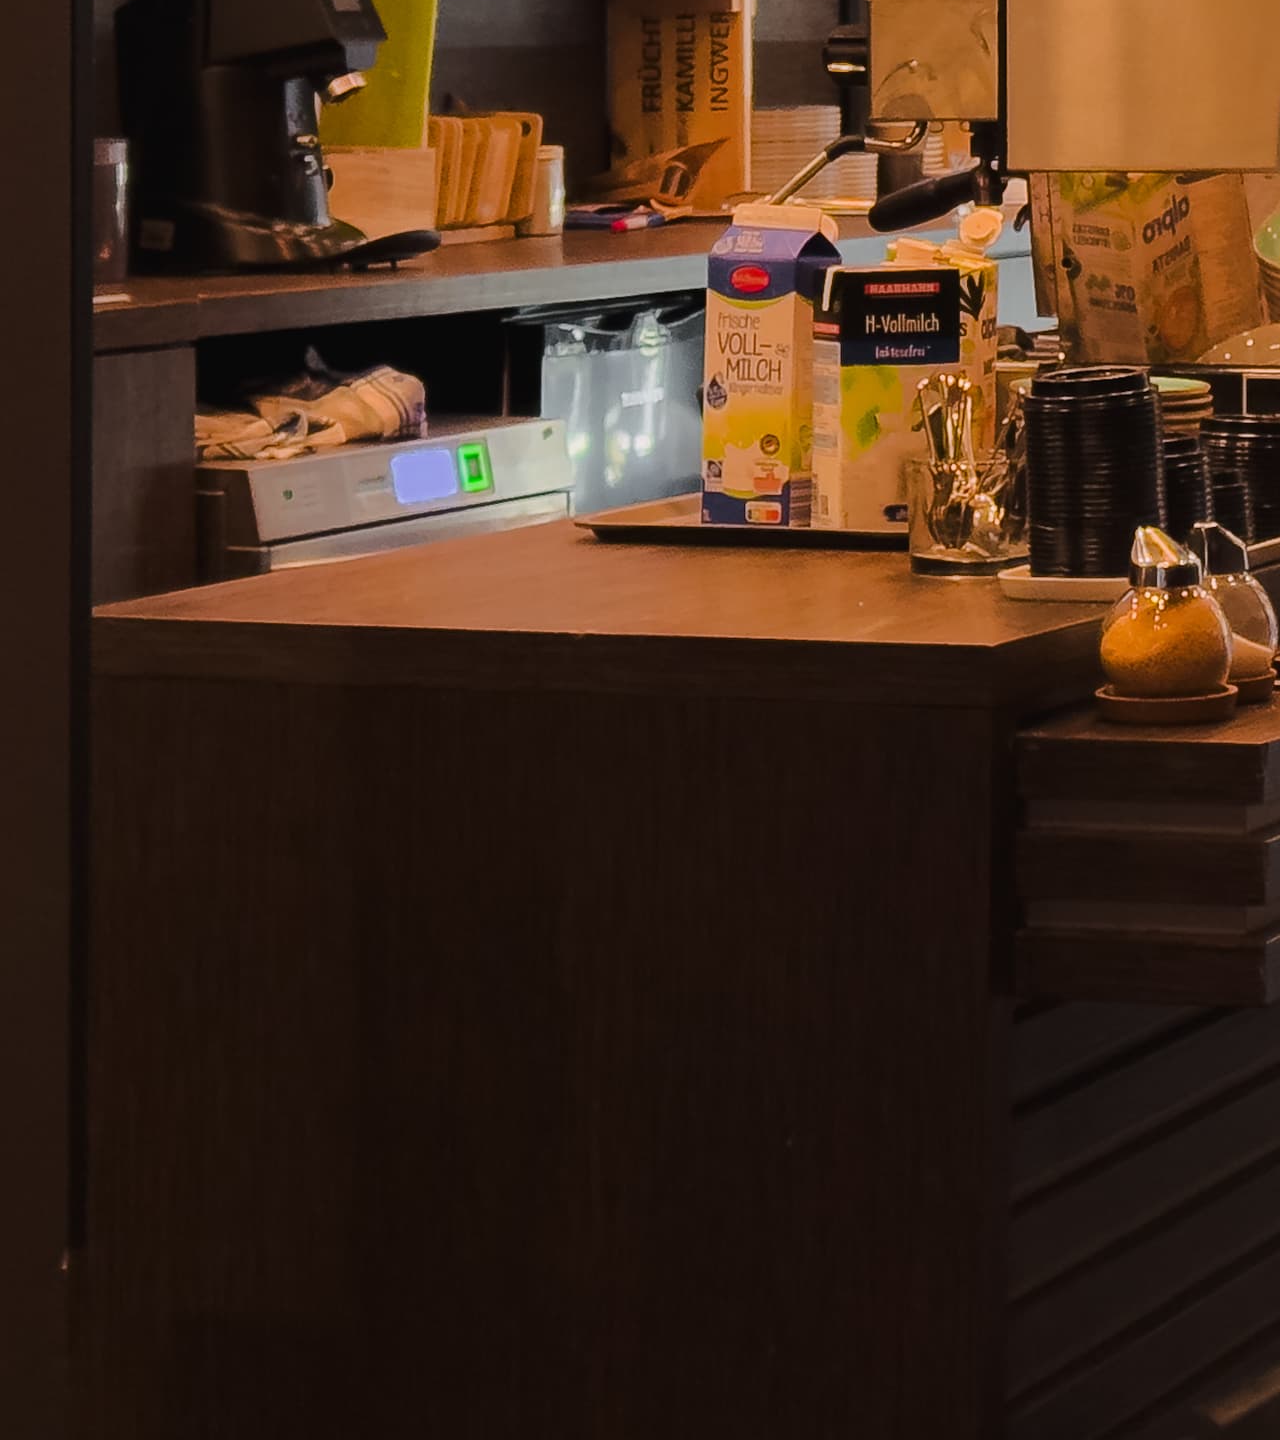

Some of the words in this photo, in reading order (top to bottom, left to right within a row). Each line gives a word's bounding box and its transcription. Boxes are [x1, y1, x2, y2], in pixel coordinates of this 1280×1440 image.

[717, 310, 761, 331] Frische
[864, 311, 940, 335] H-Vollmilch
[717, 332, 772, 357] VOLL-
[725, 357, 782, 382] MILCH
